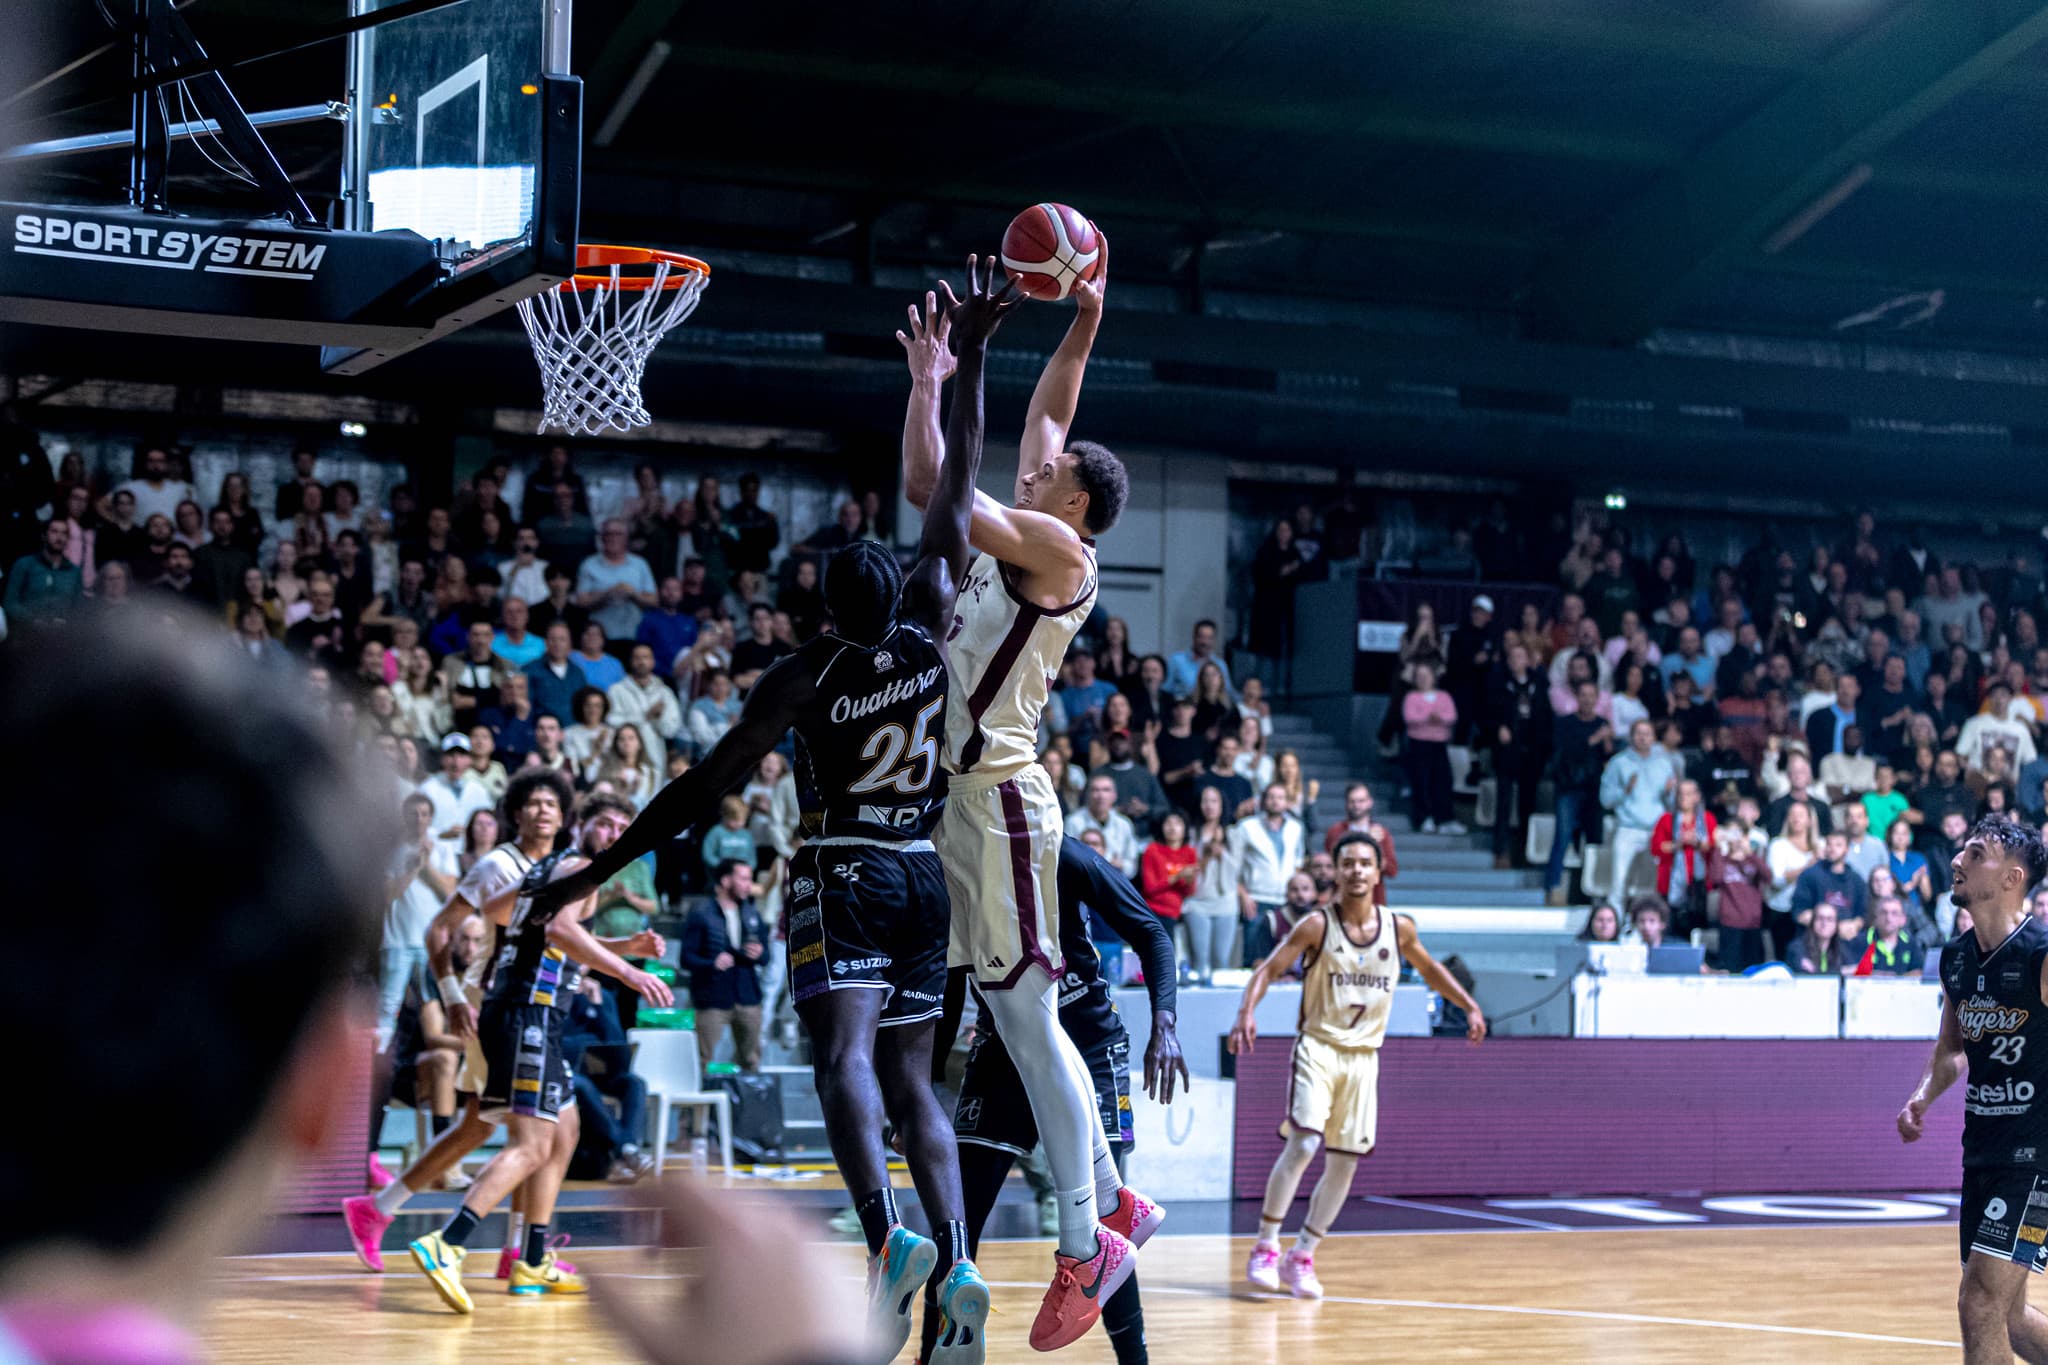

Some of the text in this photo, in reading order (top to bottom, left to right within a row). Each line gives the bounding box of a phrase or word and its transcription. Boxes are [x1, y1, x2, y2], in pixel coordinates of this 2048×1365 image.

[15, 214, 326, 270] SPORTSYSTEM
[831, 664, 943, 723] Ouattara
[847, 694, 944, 794] 25
[832, 861, 863, 882] 25
[1328, 973, 1391, 993] TOULOUSE
[1349, 1003, 1367, 1029] 7
[1957, 1002, 2025, 1038] Angers
[1989, 1035, 2026, 1065] 23
